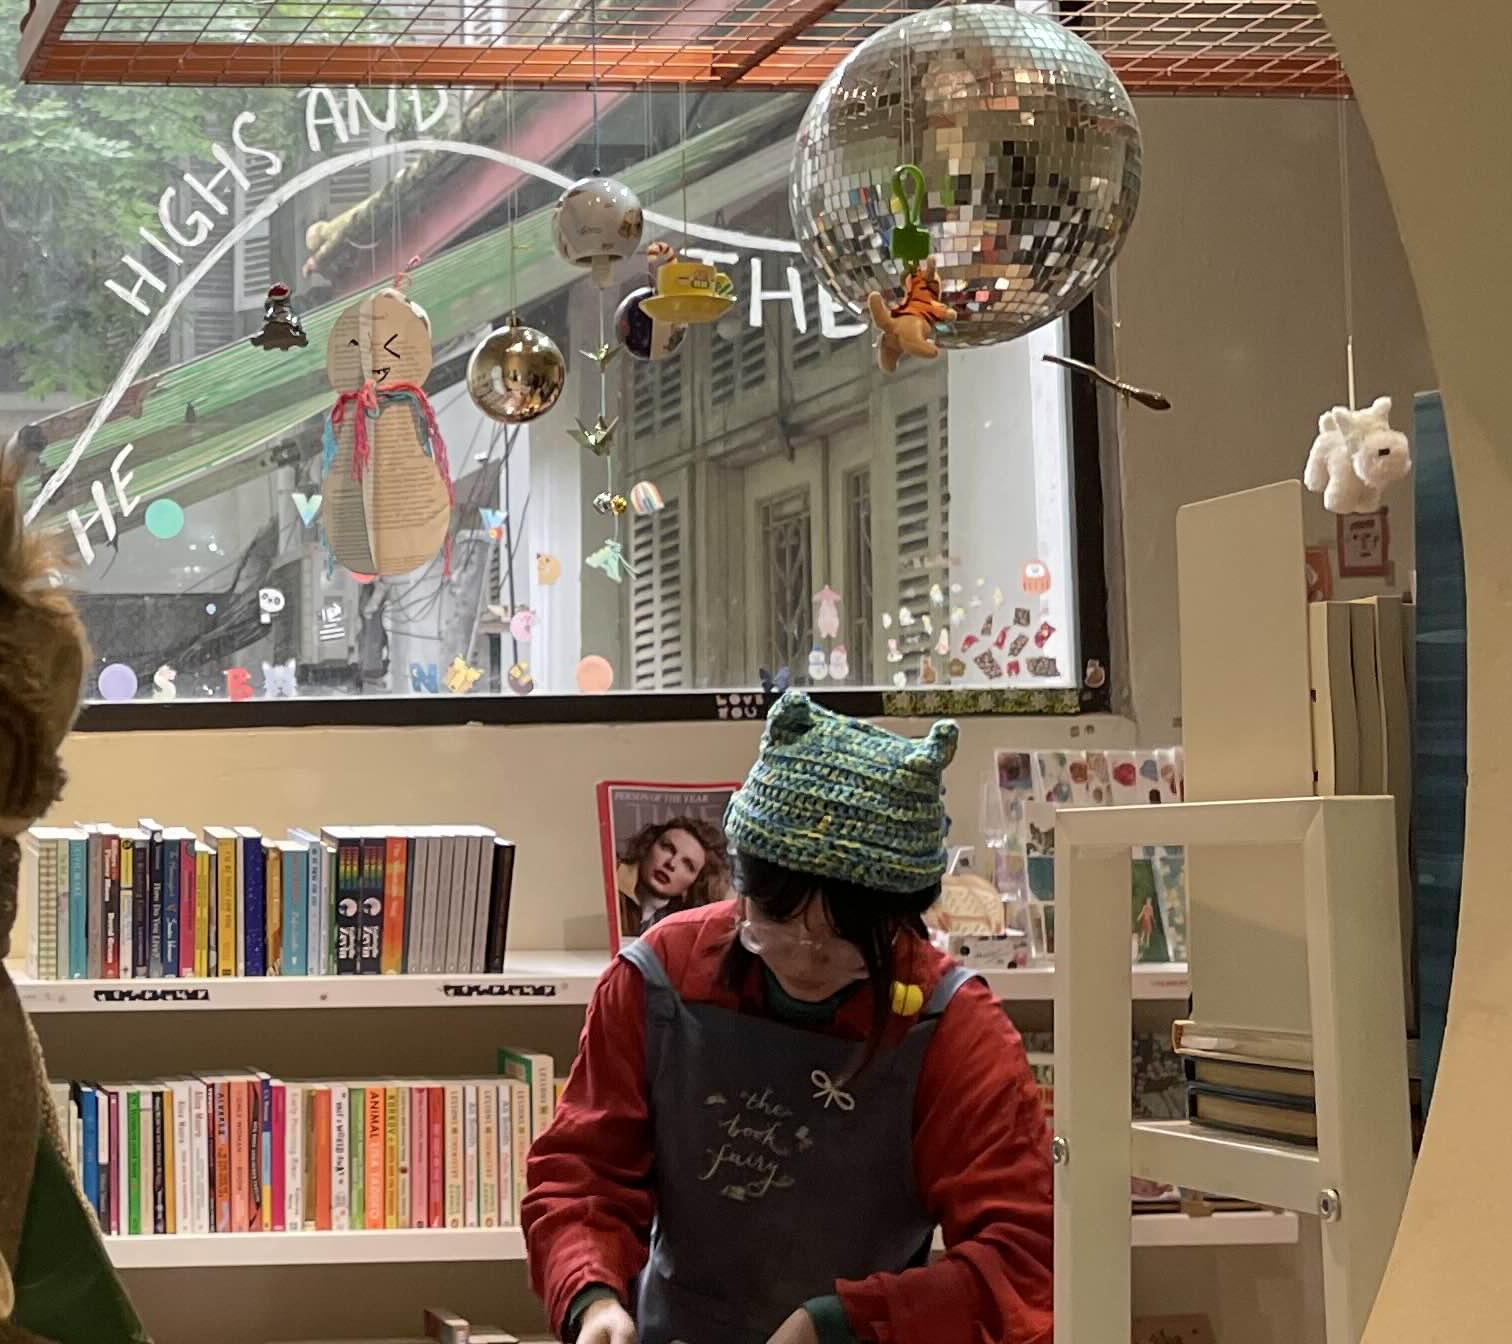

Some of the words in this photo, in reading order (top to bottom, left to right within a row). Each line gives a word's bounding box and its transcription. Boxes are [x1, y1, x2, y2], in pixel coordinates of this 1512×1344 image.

[104, 110, 285, 317] HIGHS
[299, 83, 455, 149] AND
[67, 443, 141, 564] HE
[664, 794, 680, 803] THE
[683, 794, 710, 803] YEAR
[152, 919, 160, 933] You
[153, 904, 161, 916] Do
[338, 927, 348, 959] Zevin
[361, 926, 371, 958] Zevin
[369, 1092, 380, 1139] ANIMAL
[740, 1087, 794, 1117] the
[720, 1116, 793, 1154] book
